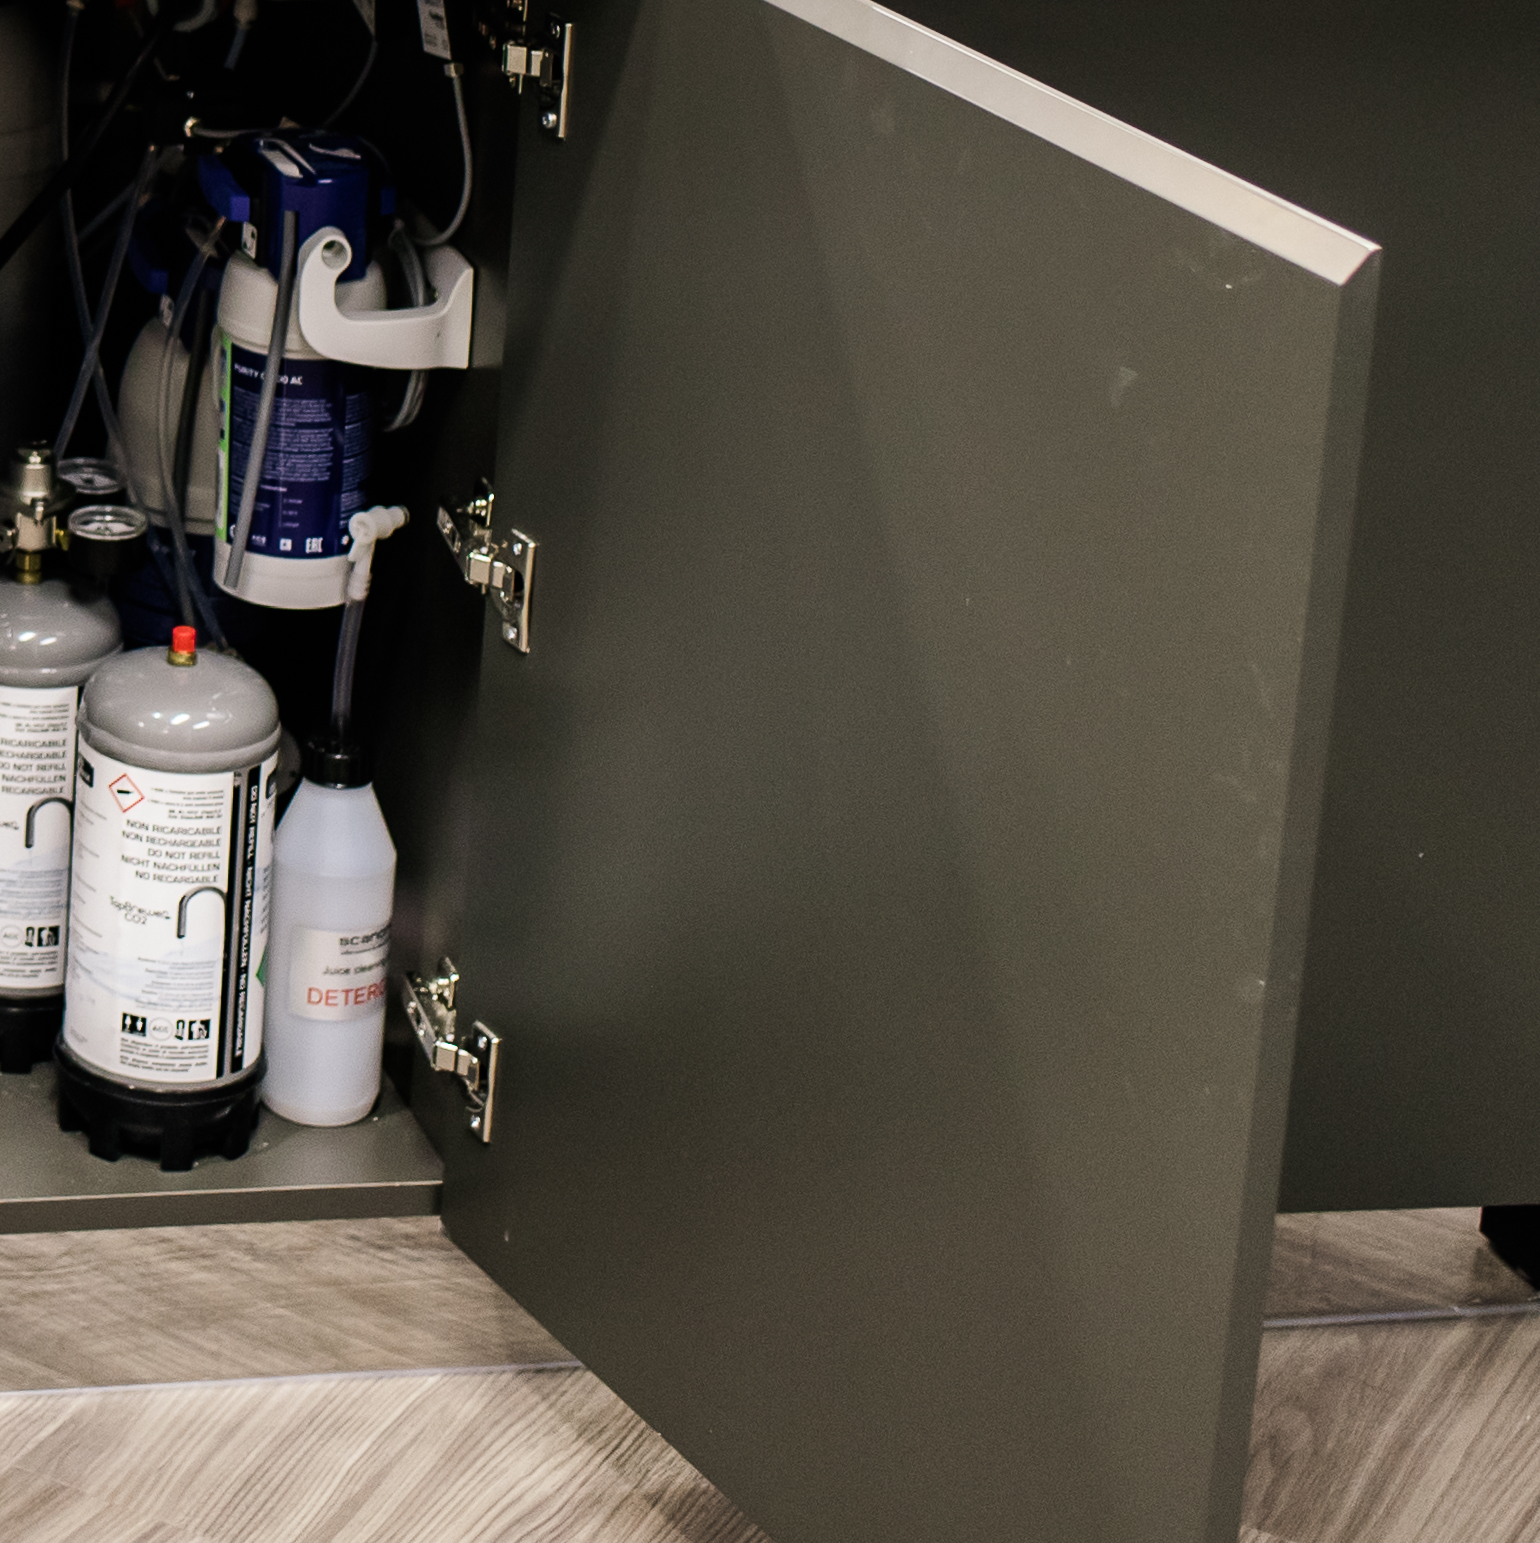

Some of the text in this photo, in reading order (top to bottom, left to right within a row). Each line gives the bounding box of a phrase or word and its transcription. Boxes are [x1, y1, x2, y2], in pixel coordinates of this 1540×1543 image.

[126, 818, 149, 831] NON
[122, 829, 143, 843] NON
[147, 848, 163, 858] DO
[165, 849, 186, 860] NOT
[134, 869, 150, 880] NO
